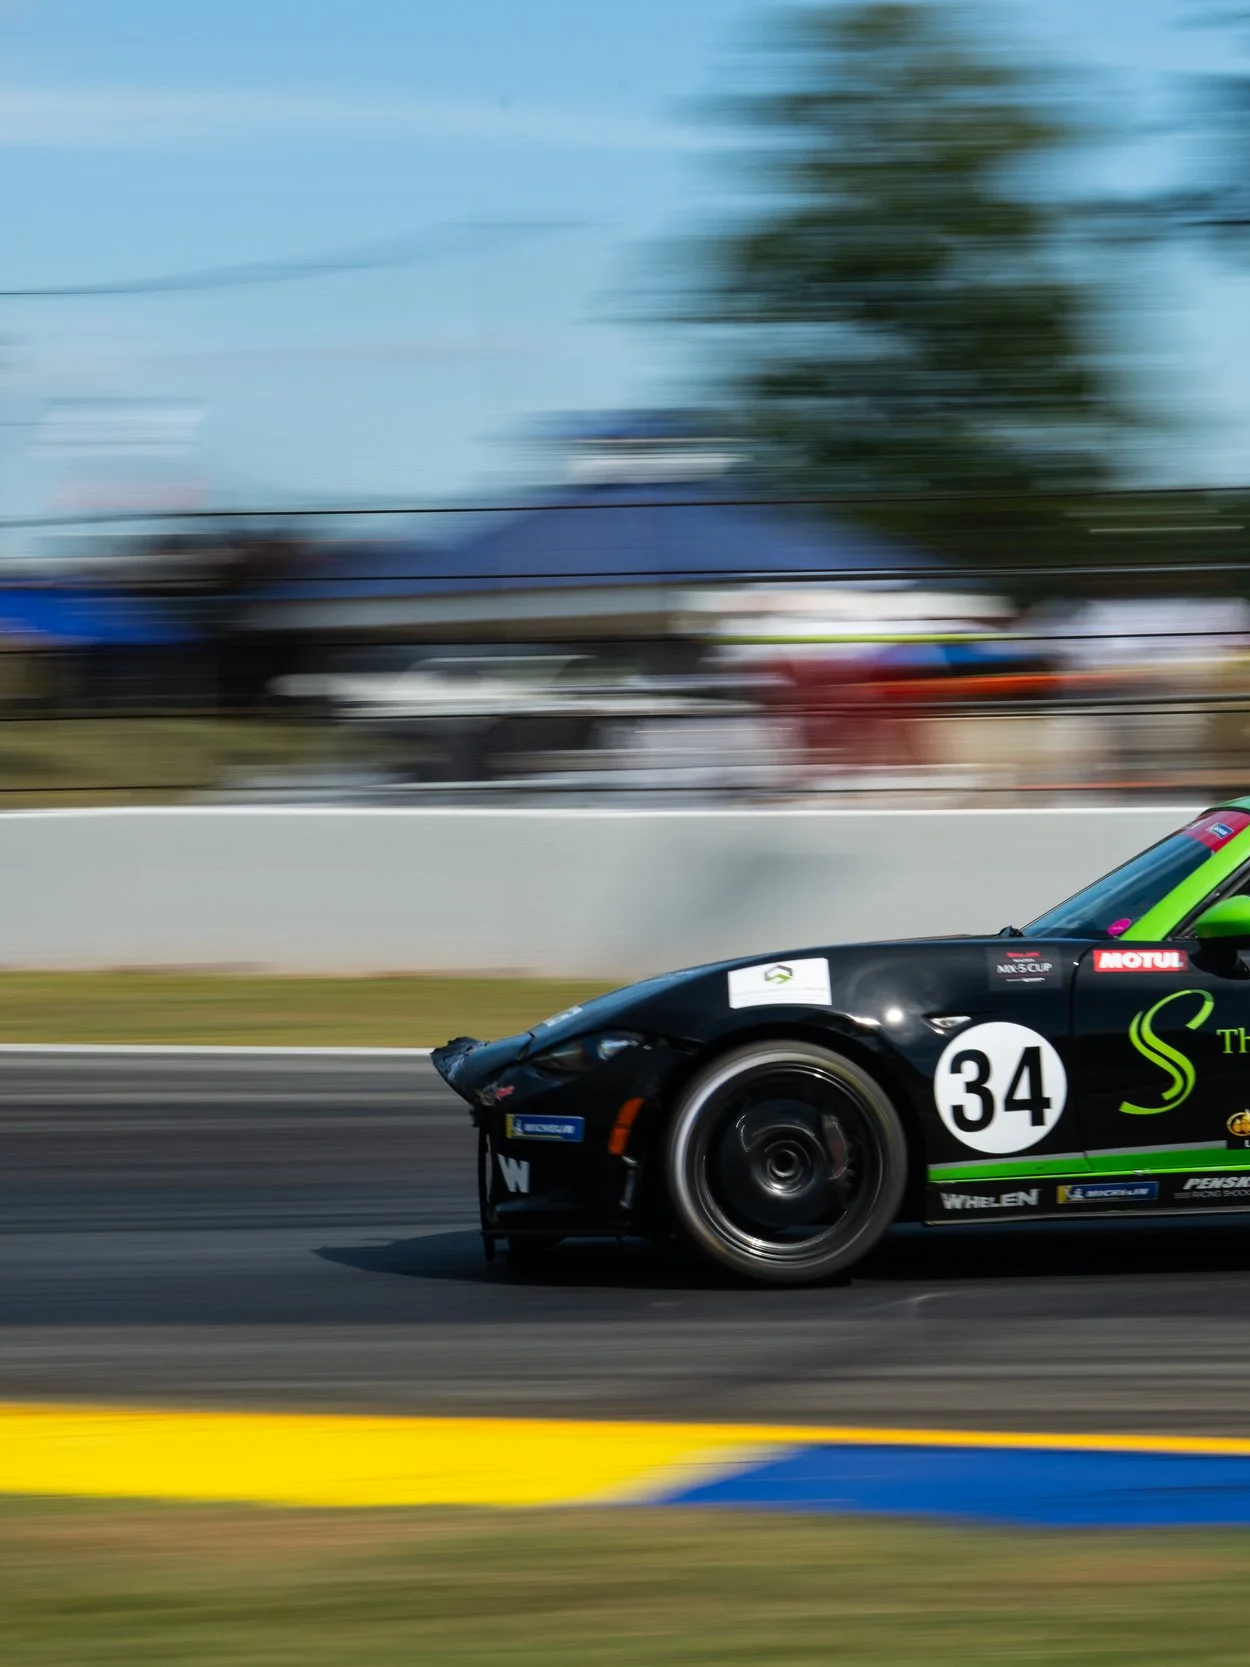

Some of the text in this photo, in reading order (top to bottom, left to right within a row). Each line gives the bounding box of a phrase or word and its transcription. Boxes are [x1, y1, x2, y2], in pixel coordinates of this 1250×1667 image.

[1098, 951, 1185, 968] MOTUL
[1119, 989, 1214, 1115] S
[949, 1046, 1052, 1133] 34
[497, 1153, 531, 1194] W
[940, 1188, 1041, 1210] WHELEN
[1086, 1187, 1149, 1198] MICHELIN
[1191, 1190, 1222, 1198] RACING
